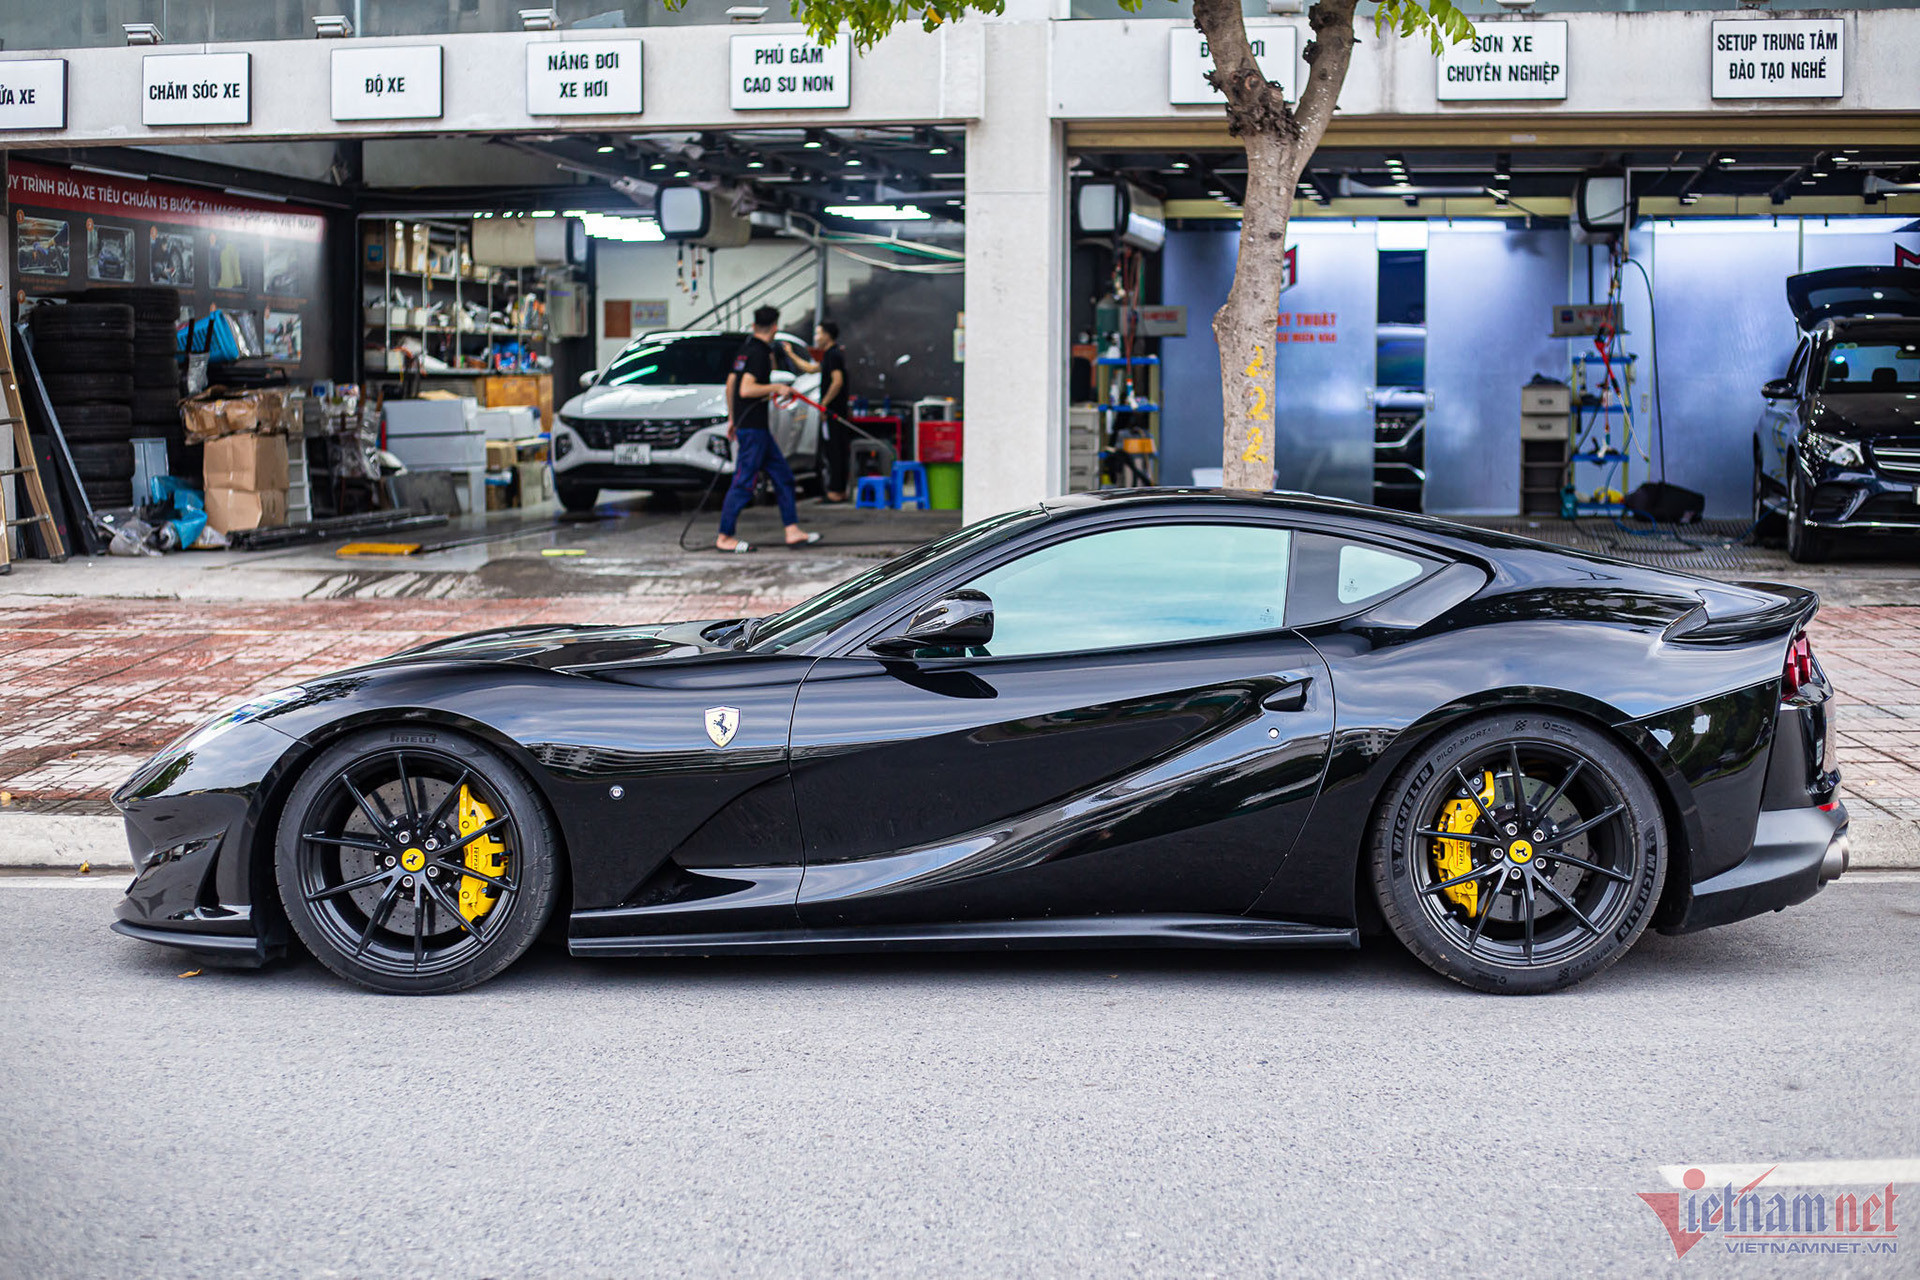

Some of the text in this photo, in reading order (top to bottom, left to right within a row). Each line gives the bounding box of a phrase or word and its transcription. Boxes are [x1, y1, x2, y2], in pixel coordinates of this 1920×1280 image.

[1472, 34, 1533, 53] SƠN XE
[1717, 29, 1838, 52] SETUP TRUNG TÂM
[1447, 61, 1560, 84] CHUYÊN NGHIỆP
[1729, 58, 1755, 80] ĐÀO
[1760, 62, 1785, 83] TẠO
[0, 84, 36, 105] ỬA XE
[149, 80, 240, 100] CHĂM SÓC XE
[387, 77, 405, 93] XE
[559, 79, 608, 98] XE HƠI
[743, 75, 834, 93] CAO SU NON
[22, 174, 55, 195] TRÌNH
[82, 185, 96, 200] XE
[97, 185, 120, 204] TIÊU
[389, 730, 438, 744] PIRELLI
[1436, 743, 1457, 762] PILOT
[1459, 728, 1487, 746] SPORT
[1393, 765, 1431, 854] MICHELIN
[1620, 852, 1657, 938] MICHELIN
